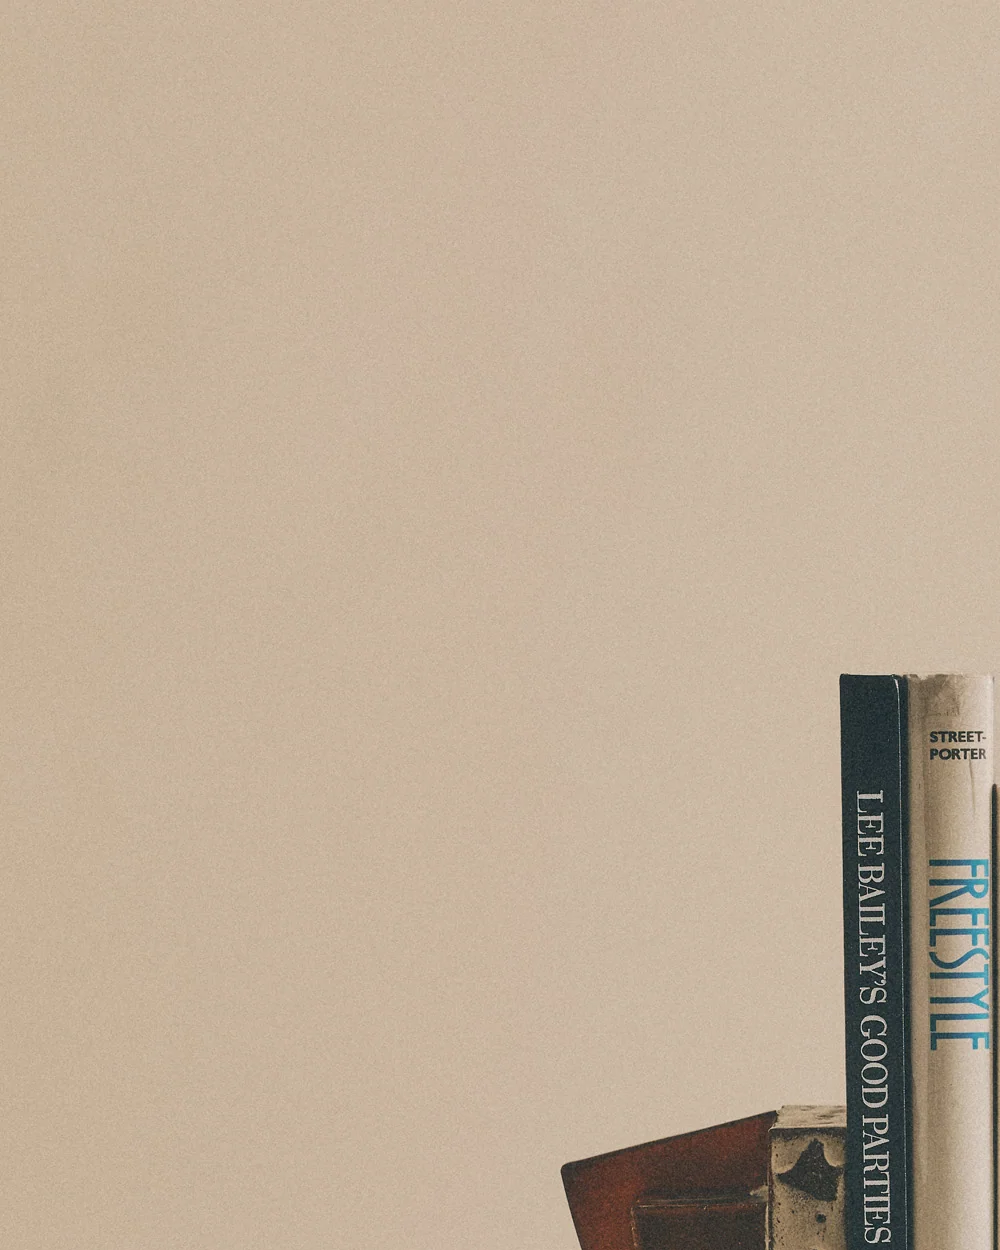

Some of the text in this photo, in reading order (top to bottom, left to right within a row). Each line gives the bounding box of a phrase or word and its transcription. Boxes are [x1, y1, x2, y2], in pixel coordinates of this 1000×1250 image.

[929, 731, 987, 743] STREET-
[929, 748, 987, 760] PORTER
[928, 859, 991, 1051] FREESTYLE
[856, 790, 892, 1245] LEE BAILEY'S GOOD PARTIES
